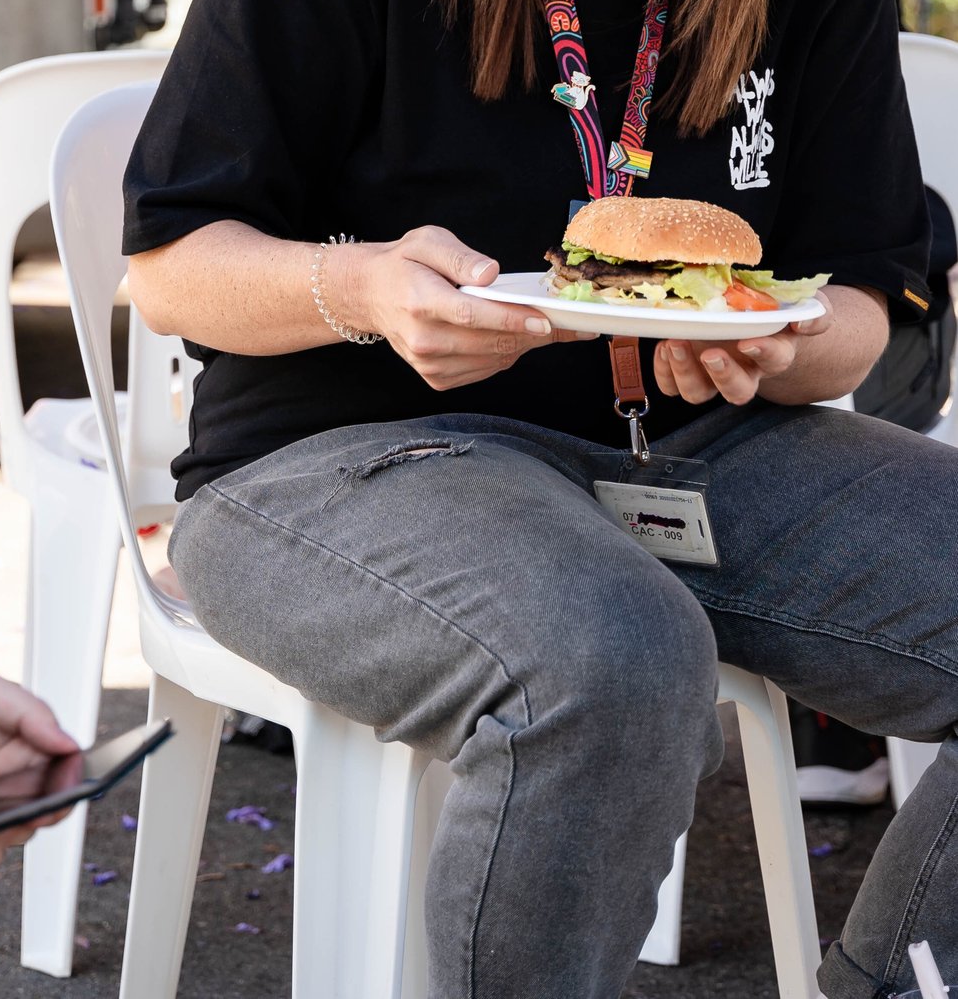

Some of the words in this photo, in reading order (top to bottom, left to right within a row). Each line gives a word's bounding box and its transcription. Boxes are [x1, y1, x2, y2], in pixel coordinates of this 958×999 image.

[622, 512, 634, 522] 07
[631, 526, 655, 537] CAC
[664, 530, 683, 541] 009
